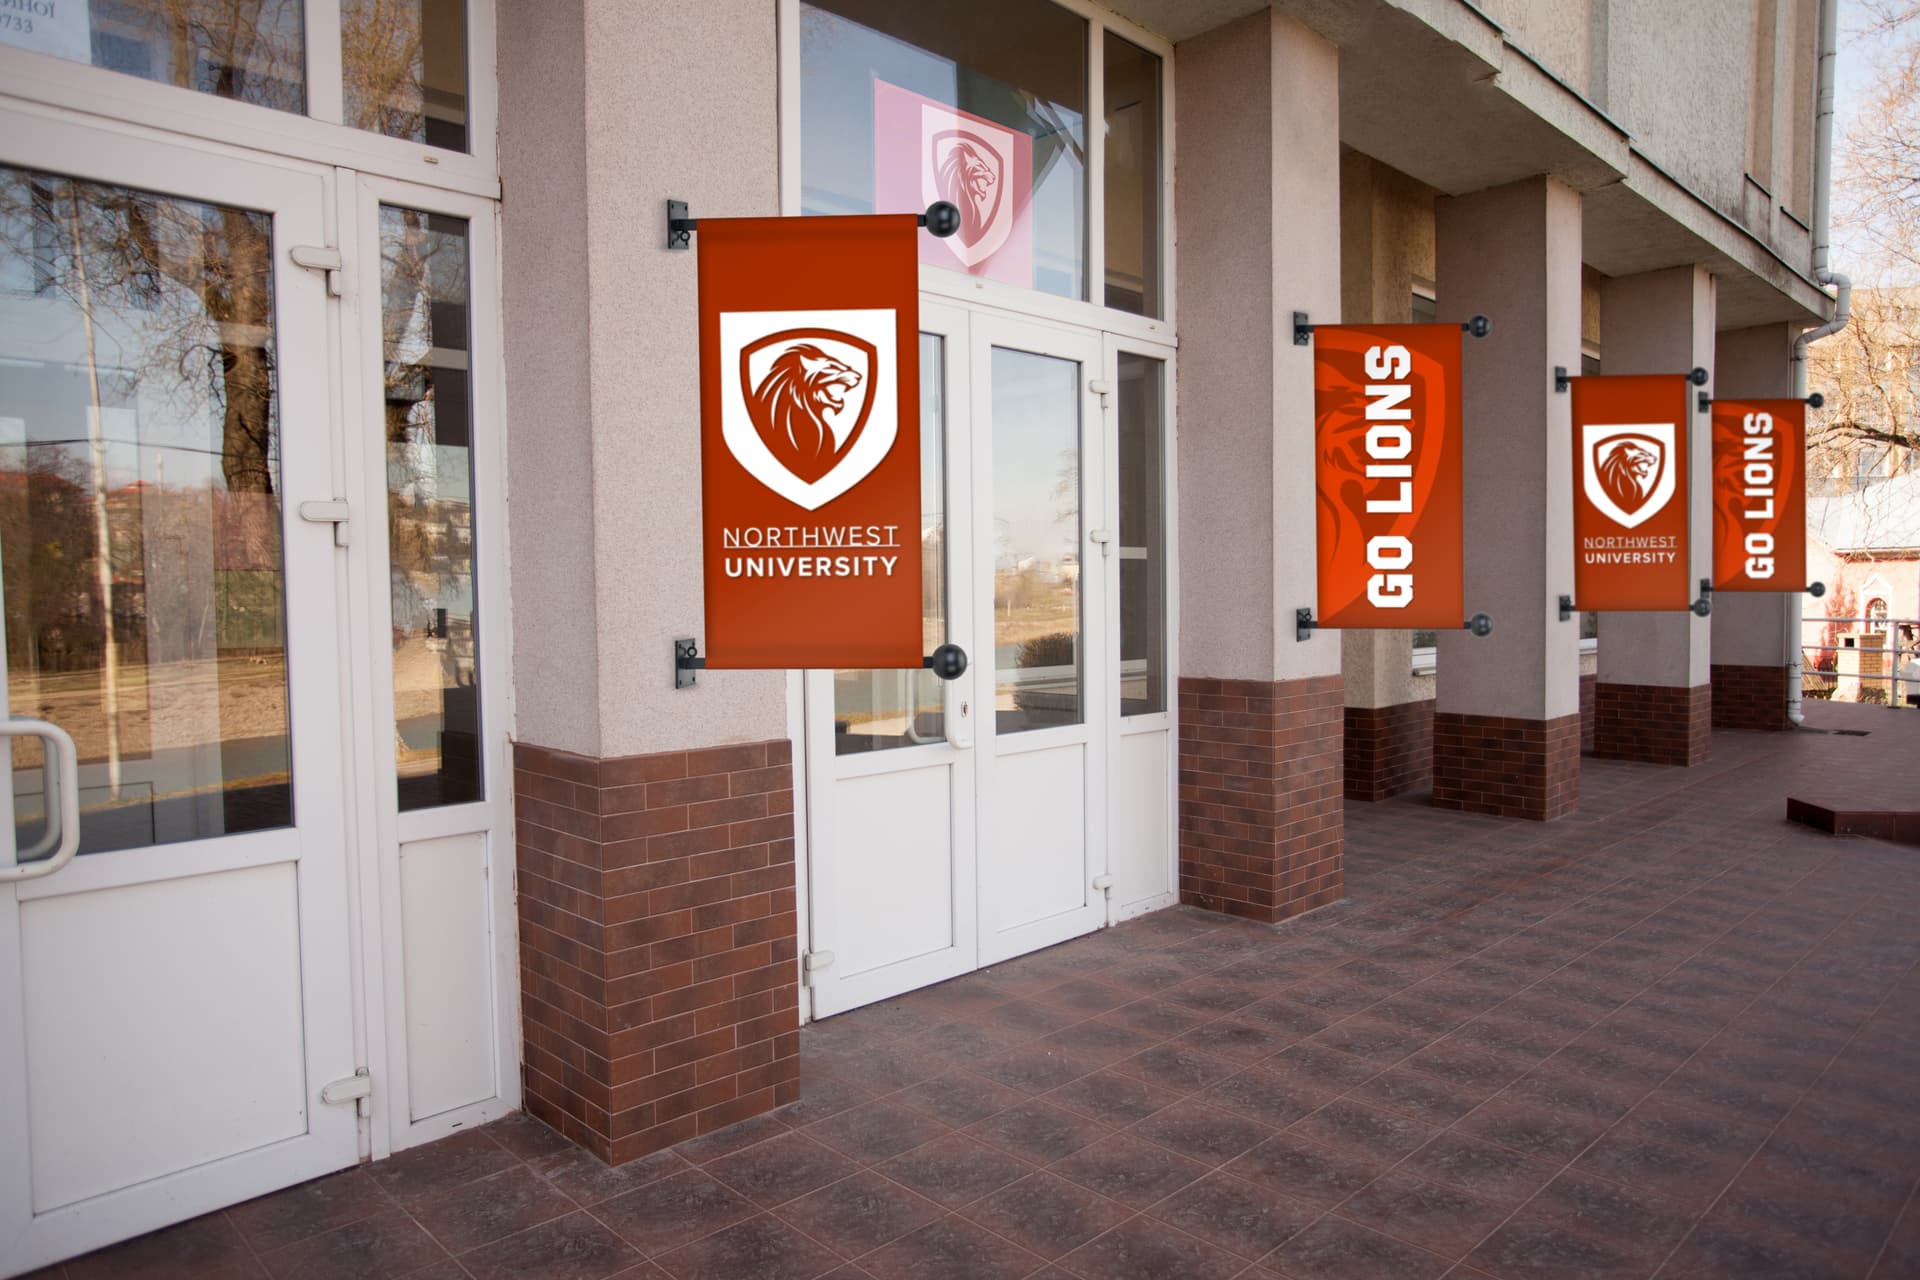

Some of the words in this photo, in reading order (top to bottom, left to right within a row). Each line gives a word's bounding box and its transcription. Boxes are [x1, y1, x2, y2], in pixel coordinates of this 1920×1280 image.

[1364, 345, 1413, 513] LIONS
[1743, 412, 1774, 519] LIONS
[723, 526, 900, 548] NORTHWEST
[1584, 535, 1677, 549] NORTHWEST
[725, 556, 898, 578] UNIVERSITY
[1366, 535, 1414, 609] GO
[1585, 551, 1676, 564] UNIVERSITY
[1744, 532, 1775, 579] GO
